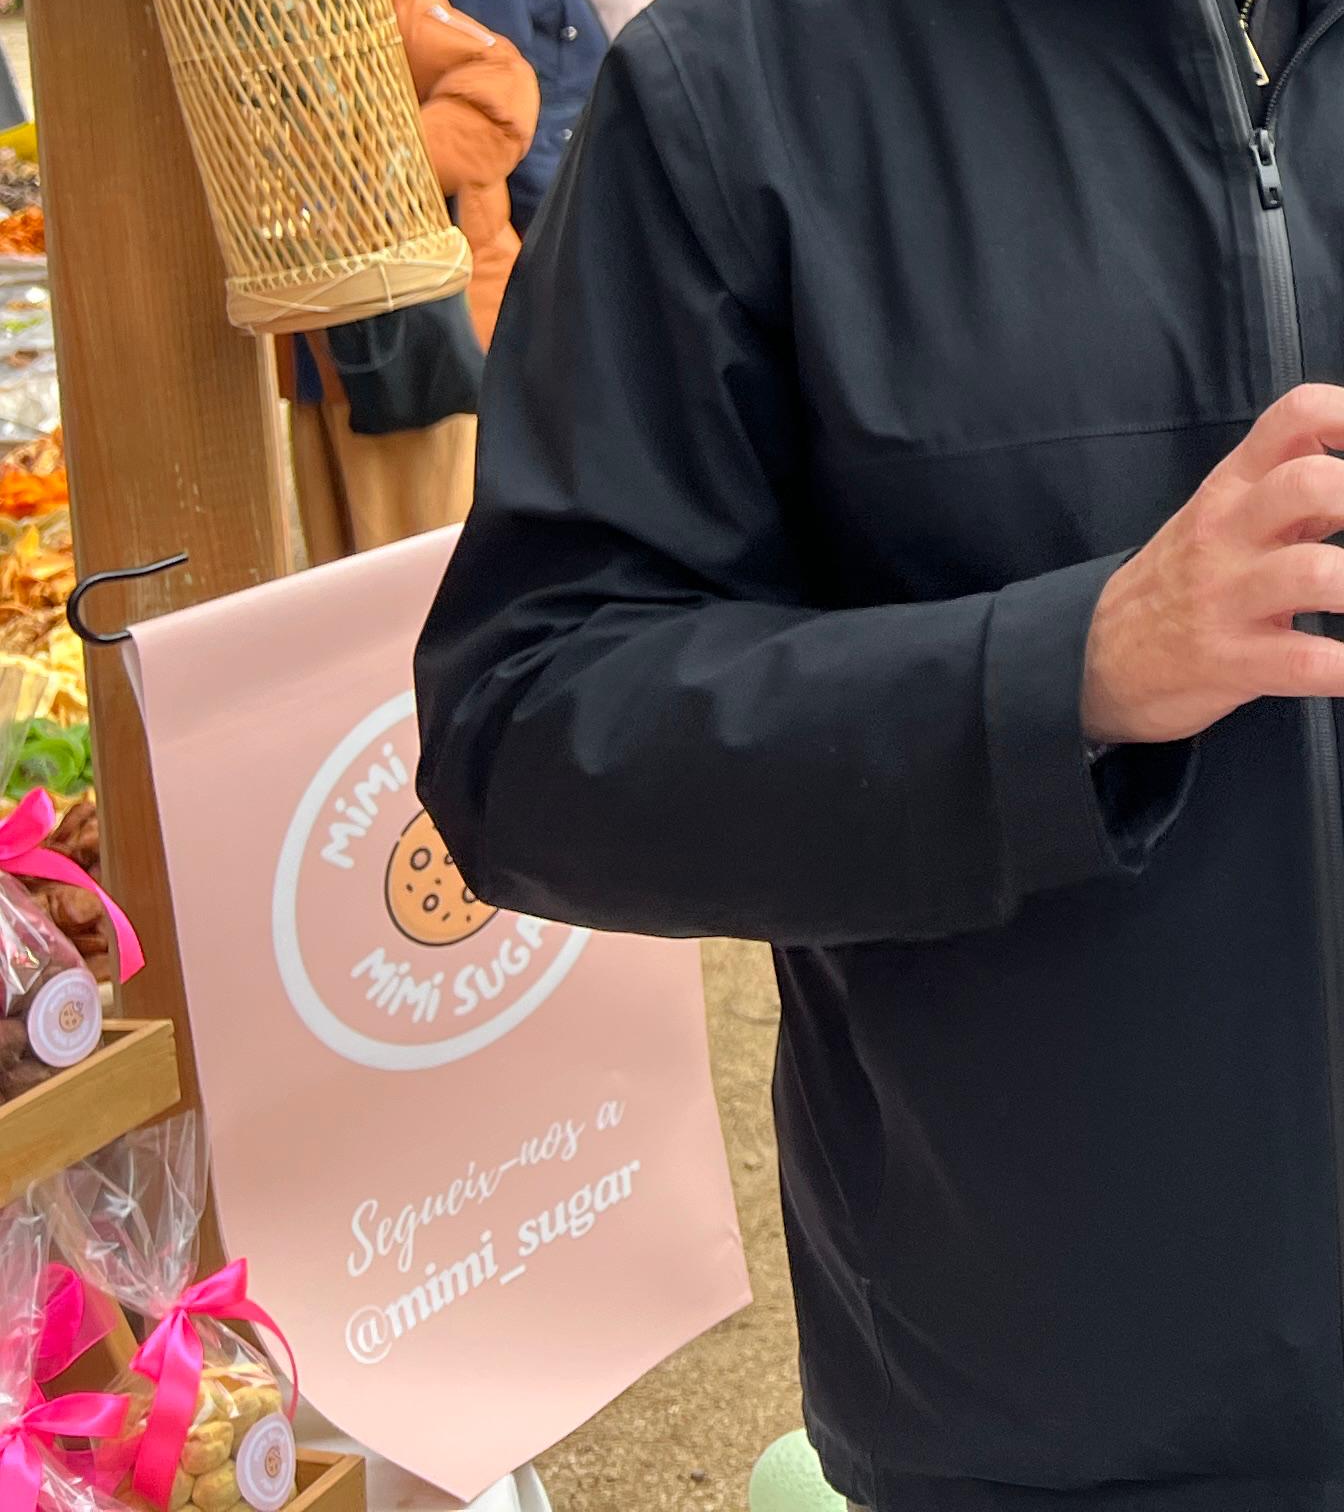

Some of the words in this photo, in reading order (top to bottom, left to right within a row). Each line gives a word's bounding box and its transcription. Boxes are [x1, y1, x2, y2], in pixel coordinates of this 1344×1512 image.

[453, 914, 550, 1016] SUGA
[345, 1159, 641, 1365] @mimi_sugar
[347, 1119, 585, 1277] Segueix-nos
[595, 1099, 626, 1131] a
